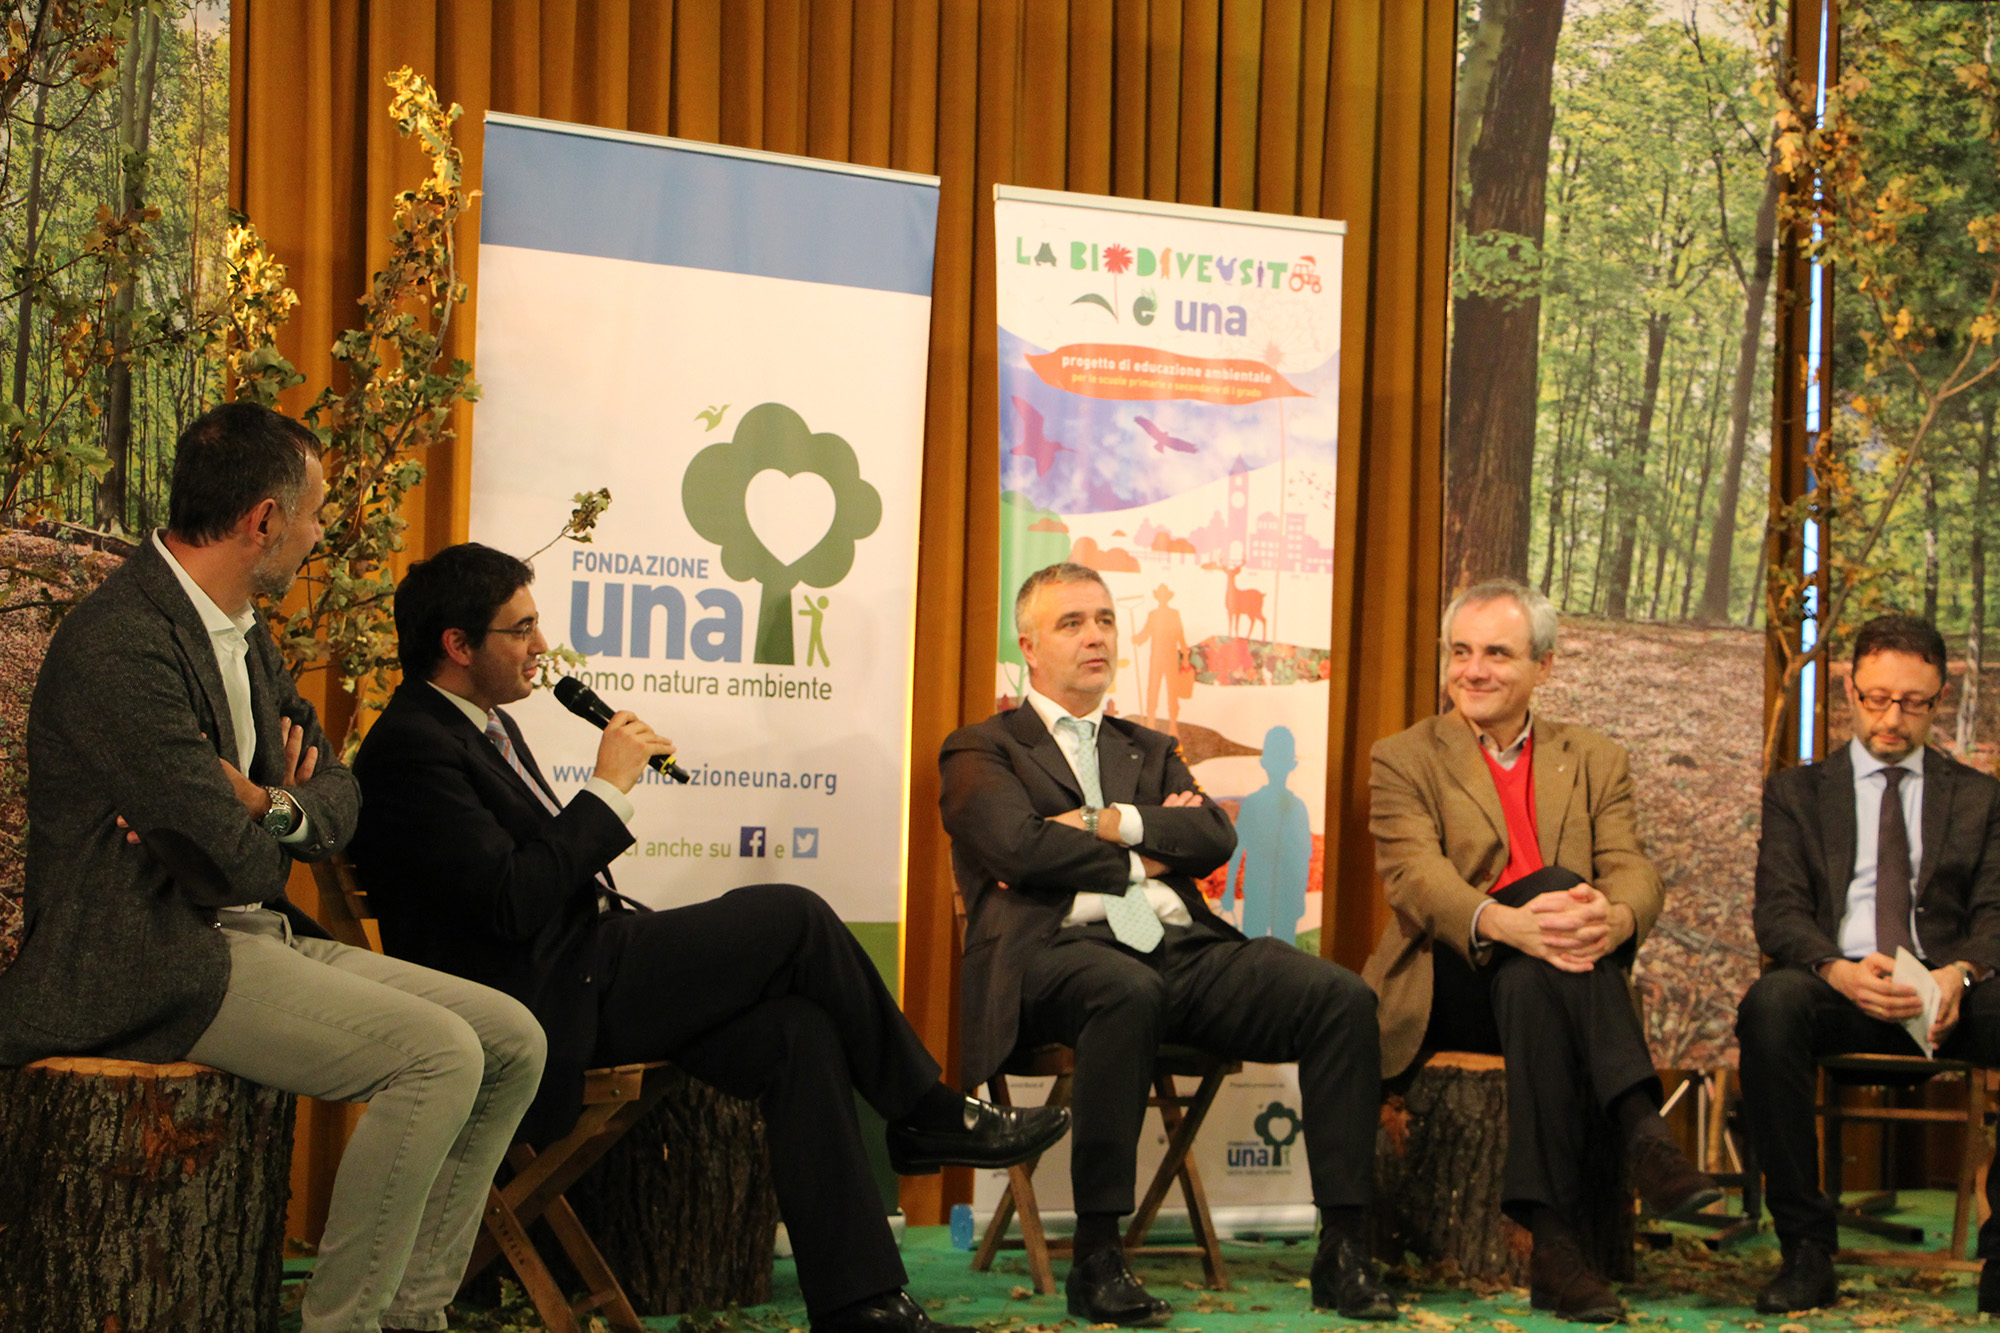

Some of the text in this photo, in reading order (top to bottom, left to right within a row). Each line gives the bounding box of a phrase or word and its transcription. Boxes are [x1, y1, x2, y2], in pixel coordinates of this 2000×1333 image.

[1174, 299, 1248, 337] una
[1061, 355, 1273, 385] progetto di educazione ambientale
[572, 550, 710, 580] FONDAZIONE
[569, 579, 744, 664] una
[643, 669, 720, 696] natura
[726, 672, 833, 701] ambiente
[645, 836, 704, 858] anche
[709, 841, 732, 858] su
[773, 842, 786, 859] e
[1227, 1148, 1269, 1168] una
